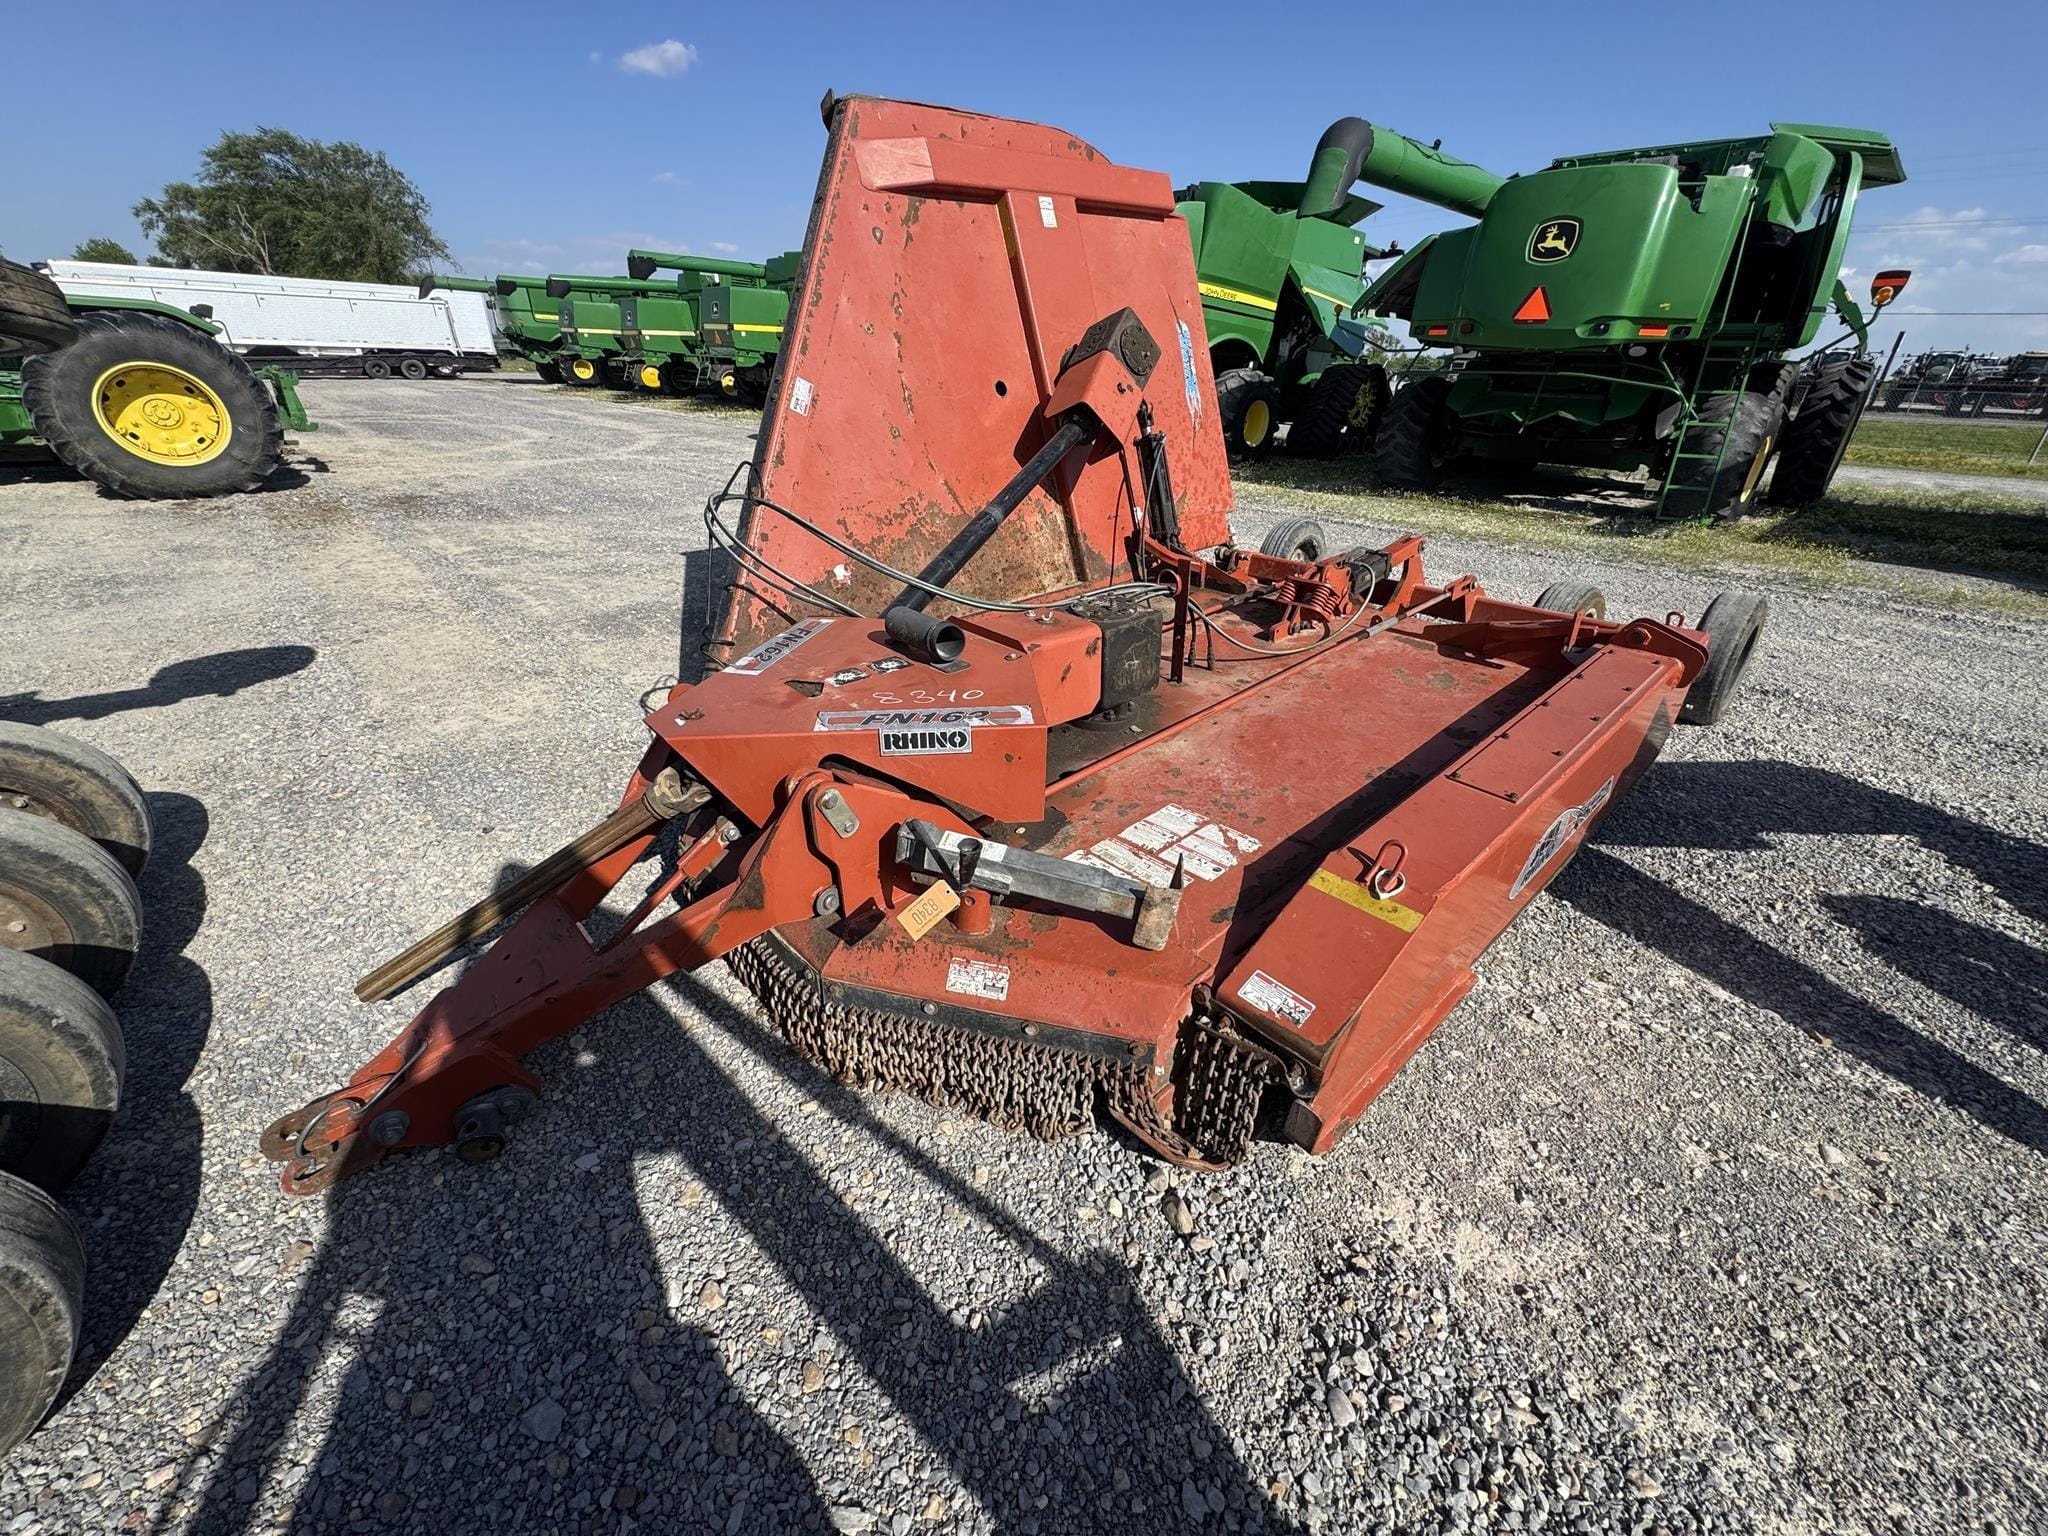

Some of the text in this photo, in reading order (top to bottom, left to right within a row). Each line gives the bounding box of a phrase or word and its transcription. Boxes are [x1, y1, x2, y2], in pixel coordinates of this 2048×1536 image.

[1205, 286, 1238, 301] JOHN DEERE
[754, 627, 812, 662] FN162
[872, 689, 984, 704] 8340
[883, 730, 968, 750] RHINO
[911, 898, 939, 926] 8340
